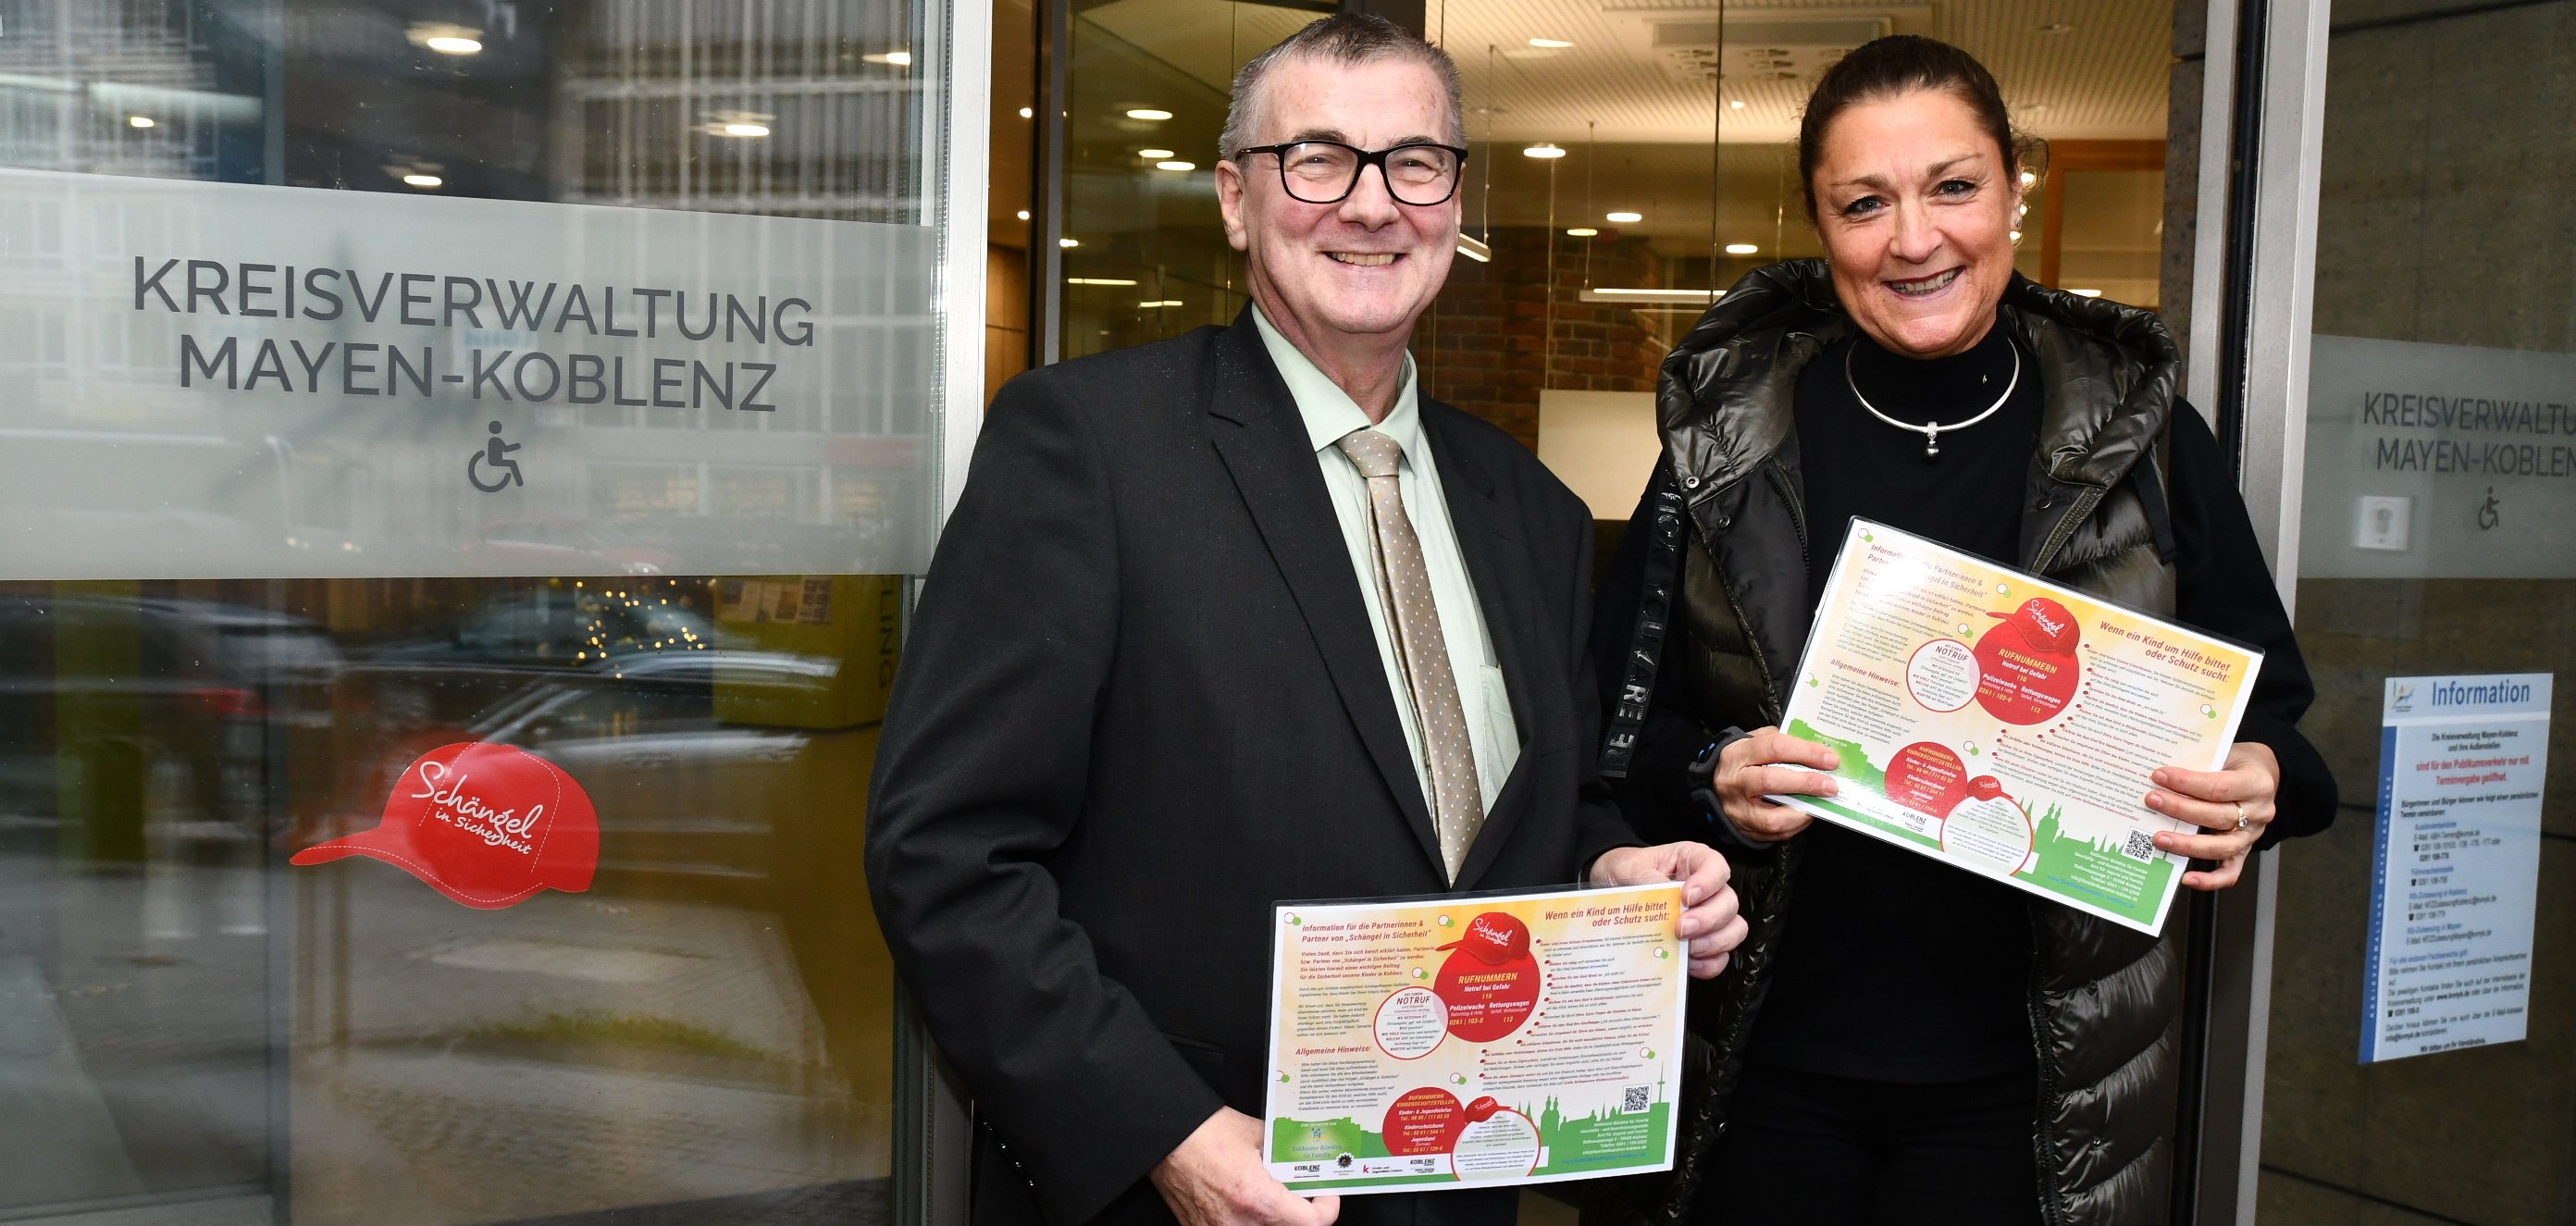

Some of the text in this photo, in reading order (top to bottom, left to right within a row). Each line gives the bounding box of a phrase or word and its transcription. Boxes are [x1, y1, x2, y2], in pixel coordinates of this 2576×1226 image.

[134, 256, 814, 347] KREISVERWALTUNG
[180, 334, 777, 412] MAYEN-KOBLENZ
[1934, 645, 1969, 662] NOTRUF
[2099, 620, 2231, 672] Wenn ein Kind um Hilfe bittet
[1997, 647, 2057, 674] RUFNUMMERN
[2144, 647, 2230, 683] oder Schutz sucht:
[1829, 657, 1901, 688] Allgemeine Hinweise:
[2000, 659, 2047, 680] Notruf bei Gefahr
[2016, 674, 2027, 682] 110
[1982, 672, 2017, 689] Polizeiwache
[1977, 686, 1992, 696] 0261
[2019, 685, 2061, 705] Rettungswagen
[2431, 678, 2531, 706] Information
[2030, 705, 2041, 714] 112
[412, 761, 543, 846] Schängel
[435, 807, 532, 855] in Sicherheit
[1545, 910, 1568, 920] Wenn
[1570, 908, 1583, 918] ein
[1586, 906, 1605, 916] Kind
[1622, 903, 1643, 913] Hilfe
[1644, 902, 1667, 911] bittet
[1591, 912, 1669, 926] oder Schutz sucht:
[1302, 922, 1344, 932] Information
[1371, 920, 1417, 929] Partnerinnen
[1301, 934, 1328, 943] Partner
[1458, 972, 1518, 984] RUFNUMMERN
[1396, 996, 1430, 1004] NOTRUF
[1449, 1003, 1485, 1011] Polizeiwache
[1489, 1000, 1529, 1009] Rettungswagen
[1295, 1045, 1371, 1056] Allgemeine Hinweise:
